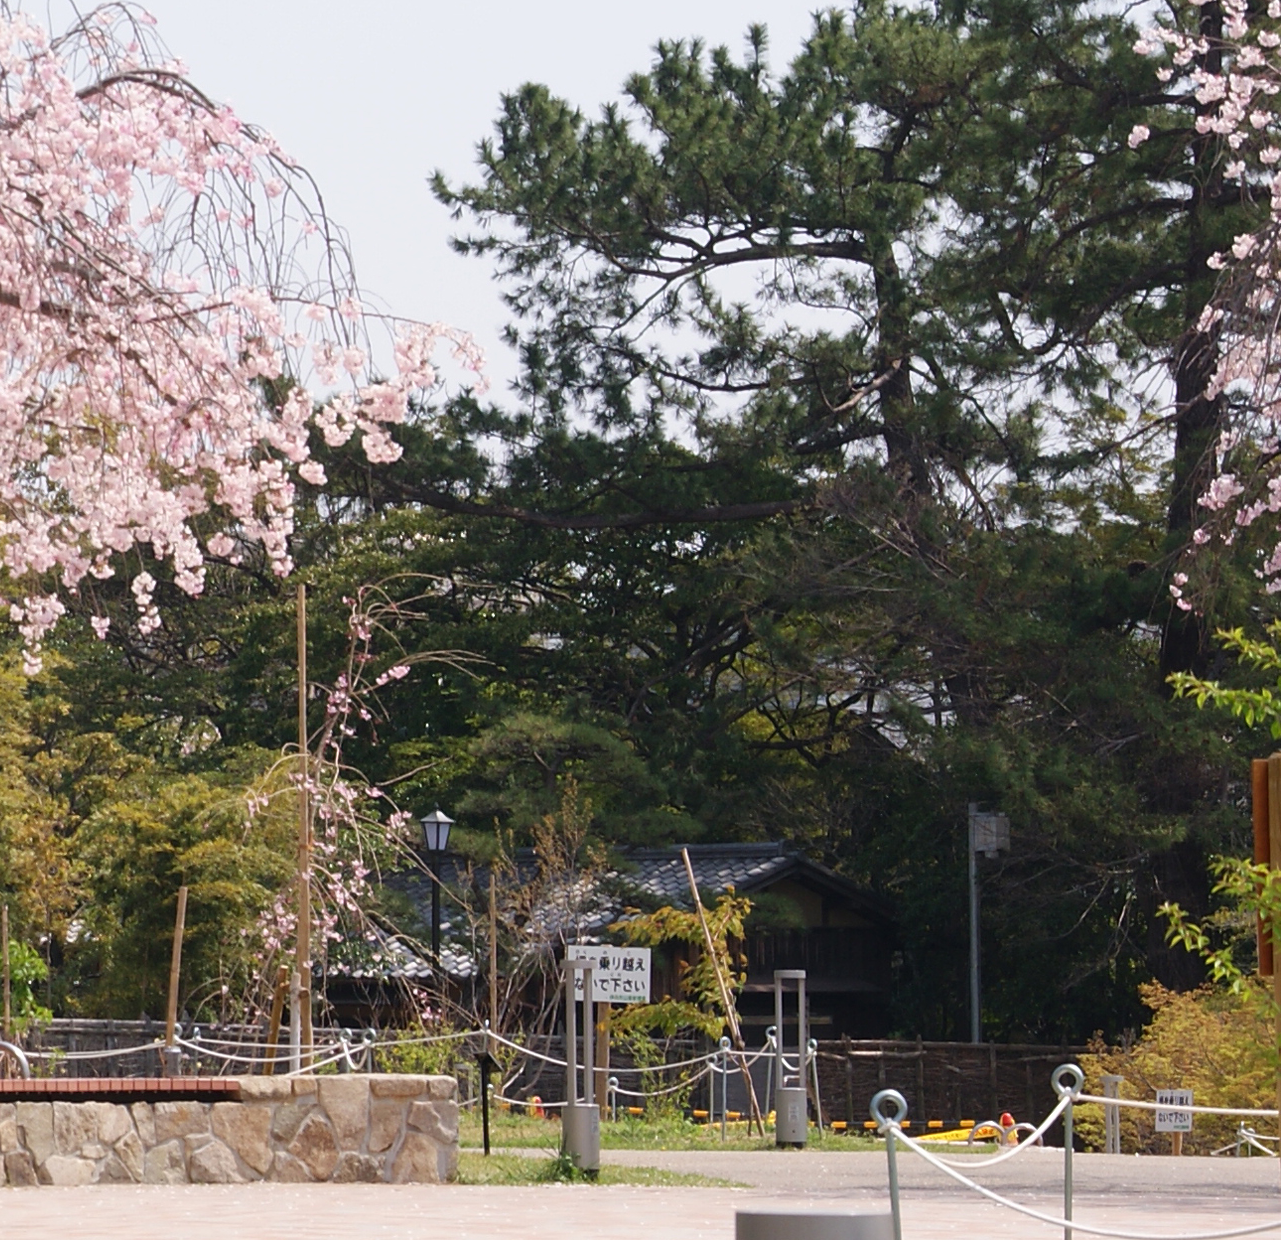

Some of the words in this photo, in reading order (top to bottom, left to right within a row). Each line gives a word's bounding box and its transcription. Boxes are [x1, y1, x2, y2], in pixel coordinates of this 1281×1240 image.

[1158, 1112, 1189, 1123] ないで下さい
